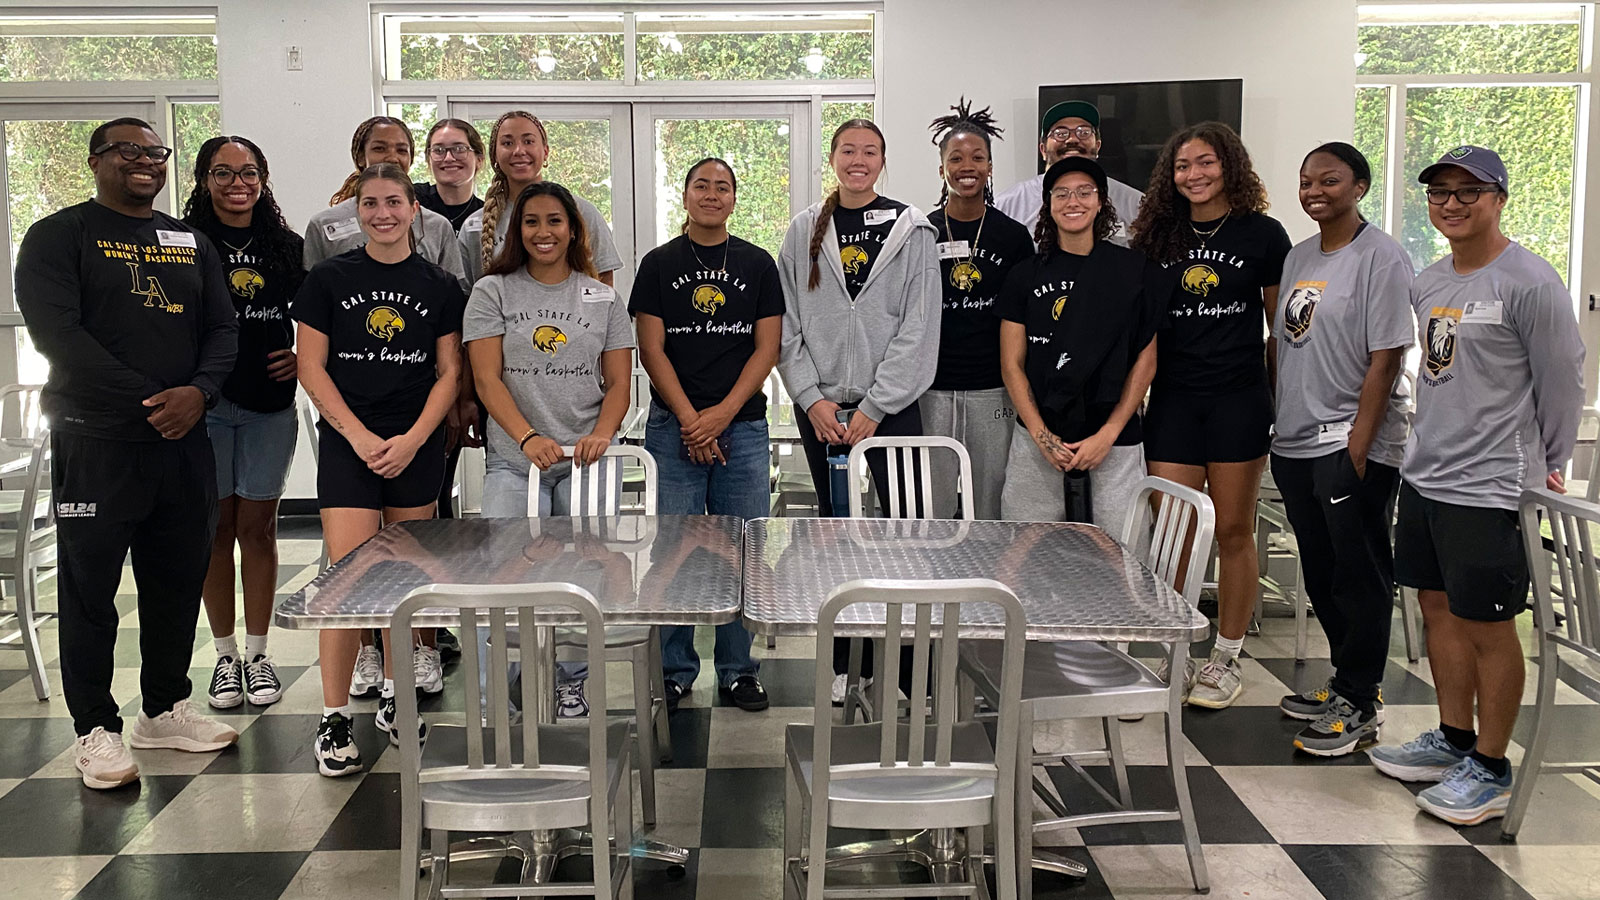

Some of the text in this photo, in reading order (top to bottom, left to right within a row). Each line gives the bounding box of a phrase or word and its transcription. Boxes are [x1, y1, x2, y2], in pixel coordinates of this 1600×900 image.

[841, 230, 871, 244] STATE
[97, 240, 196, 256] CAL STATE LOS ANGELES
[104, 249, 195, 265] WOMEN'S BASKETBALL
[989, 253, 1003, 266] LA
[1188, 249, 1244, 269] STATE LA
[126, 262, 169, 307] LA
[672, 271, 747, 292] CAL STATE LA
[1033, 283, 1055, 297] CAL
[341, 290, 428, 317] CAL STATE LA
[1198, 301, 1247, 319] basketball
[537, 309, 573, 321] STATE
[577, 317, 590, 329] LA
[667, 320, 752, 336] women's basketball
[338, 346, 428, 365] women's basketball
[994, 407, 1014, 420] GAP
